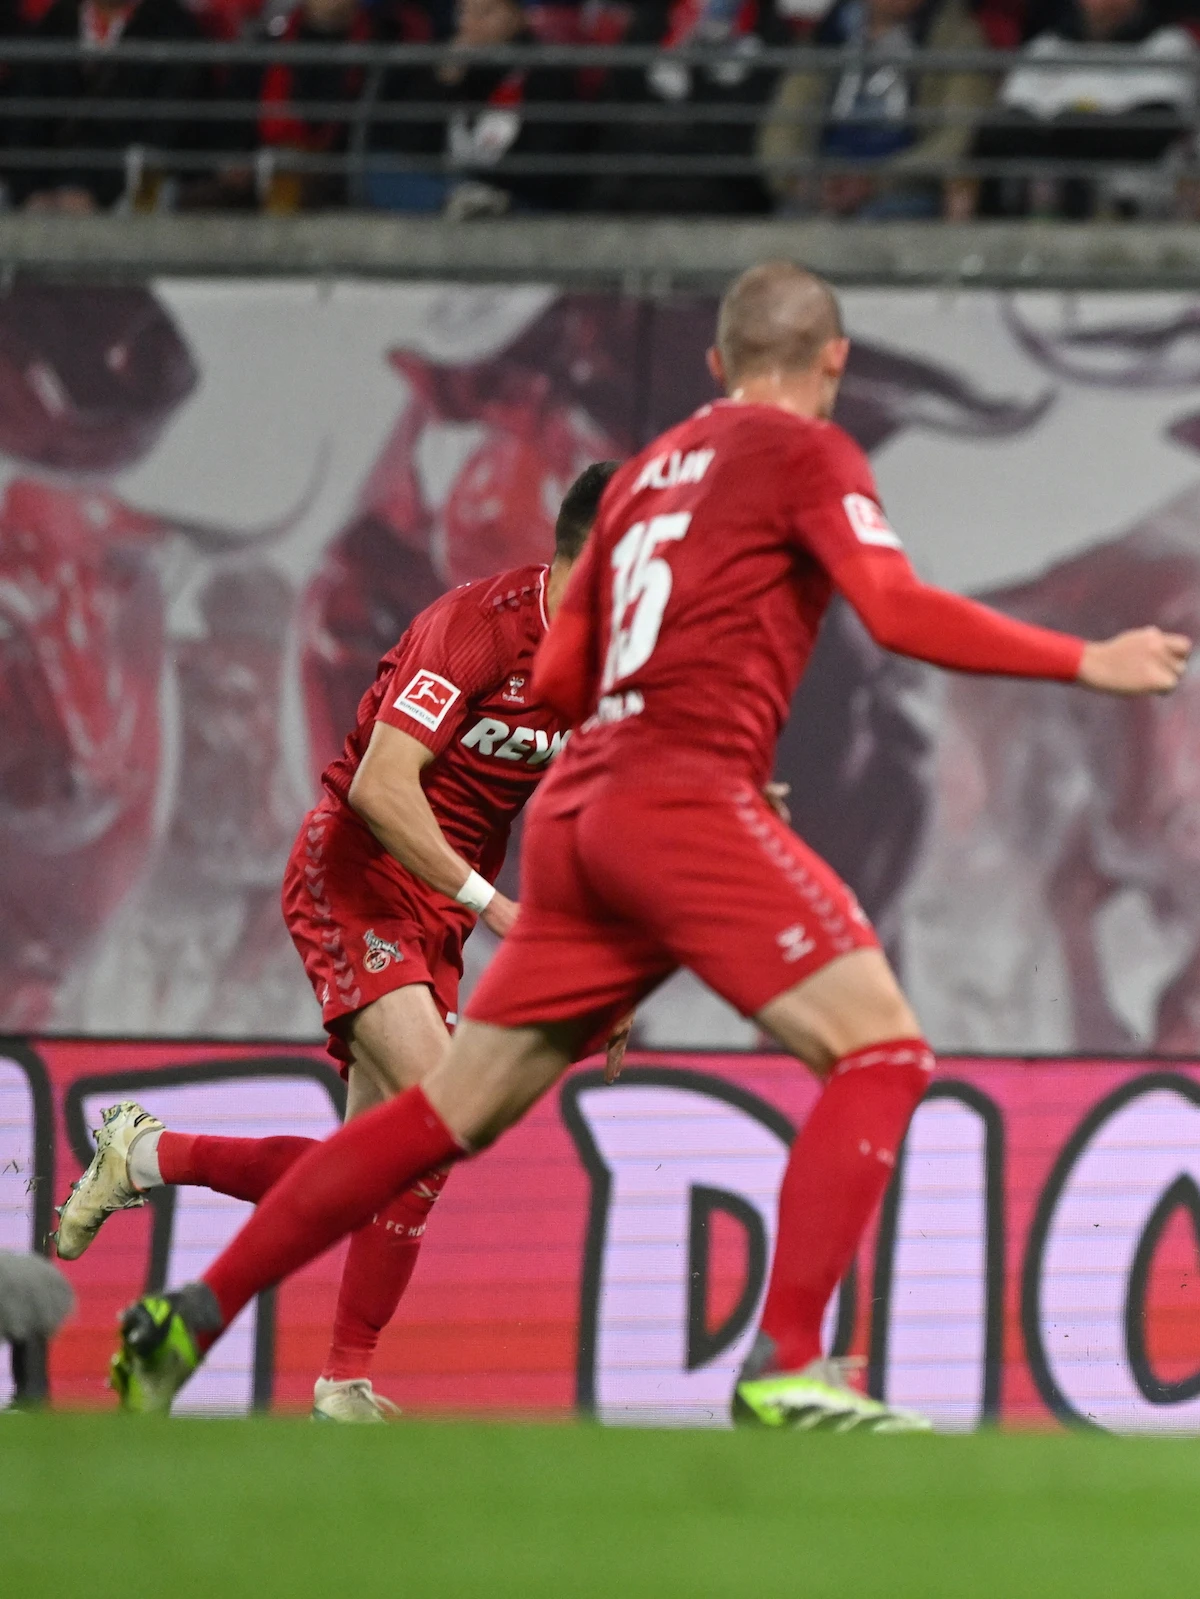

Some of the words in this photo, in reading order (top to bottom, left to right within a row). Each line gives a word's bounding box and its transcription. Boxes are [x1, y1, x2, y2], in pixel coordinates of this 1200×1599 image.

[603, 511, 692, 691] 15
[461, 717, 573, 764] REW
[385, 1220, 405, 1235] FC
